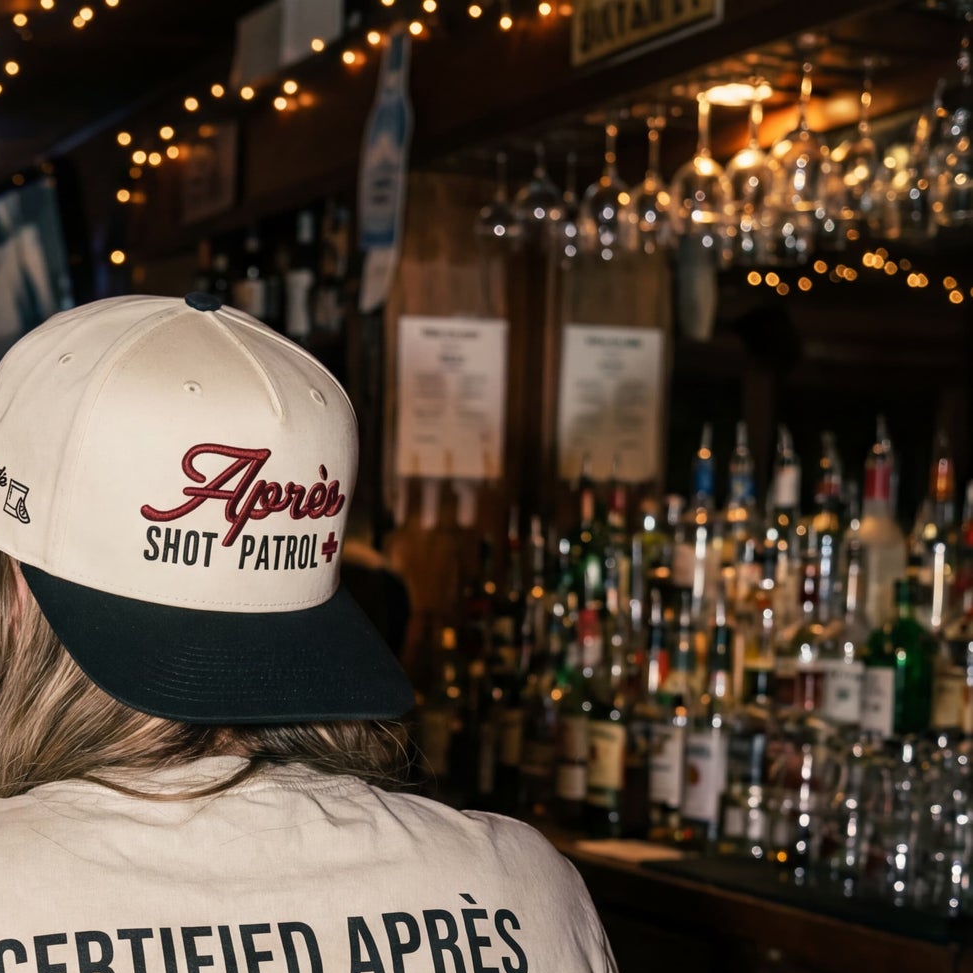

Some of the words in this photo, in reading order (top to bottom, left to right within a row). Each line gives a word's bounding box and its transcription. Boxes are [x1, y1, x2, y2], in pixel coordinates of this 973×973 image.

[141, 443, 345, 547] Après
[143, 525, 218, 567] SHOT
[238, 534, 318, 570] PATROL
